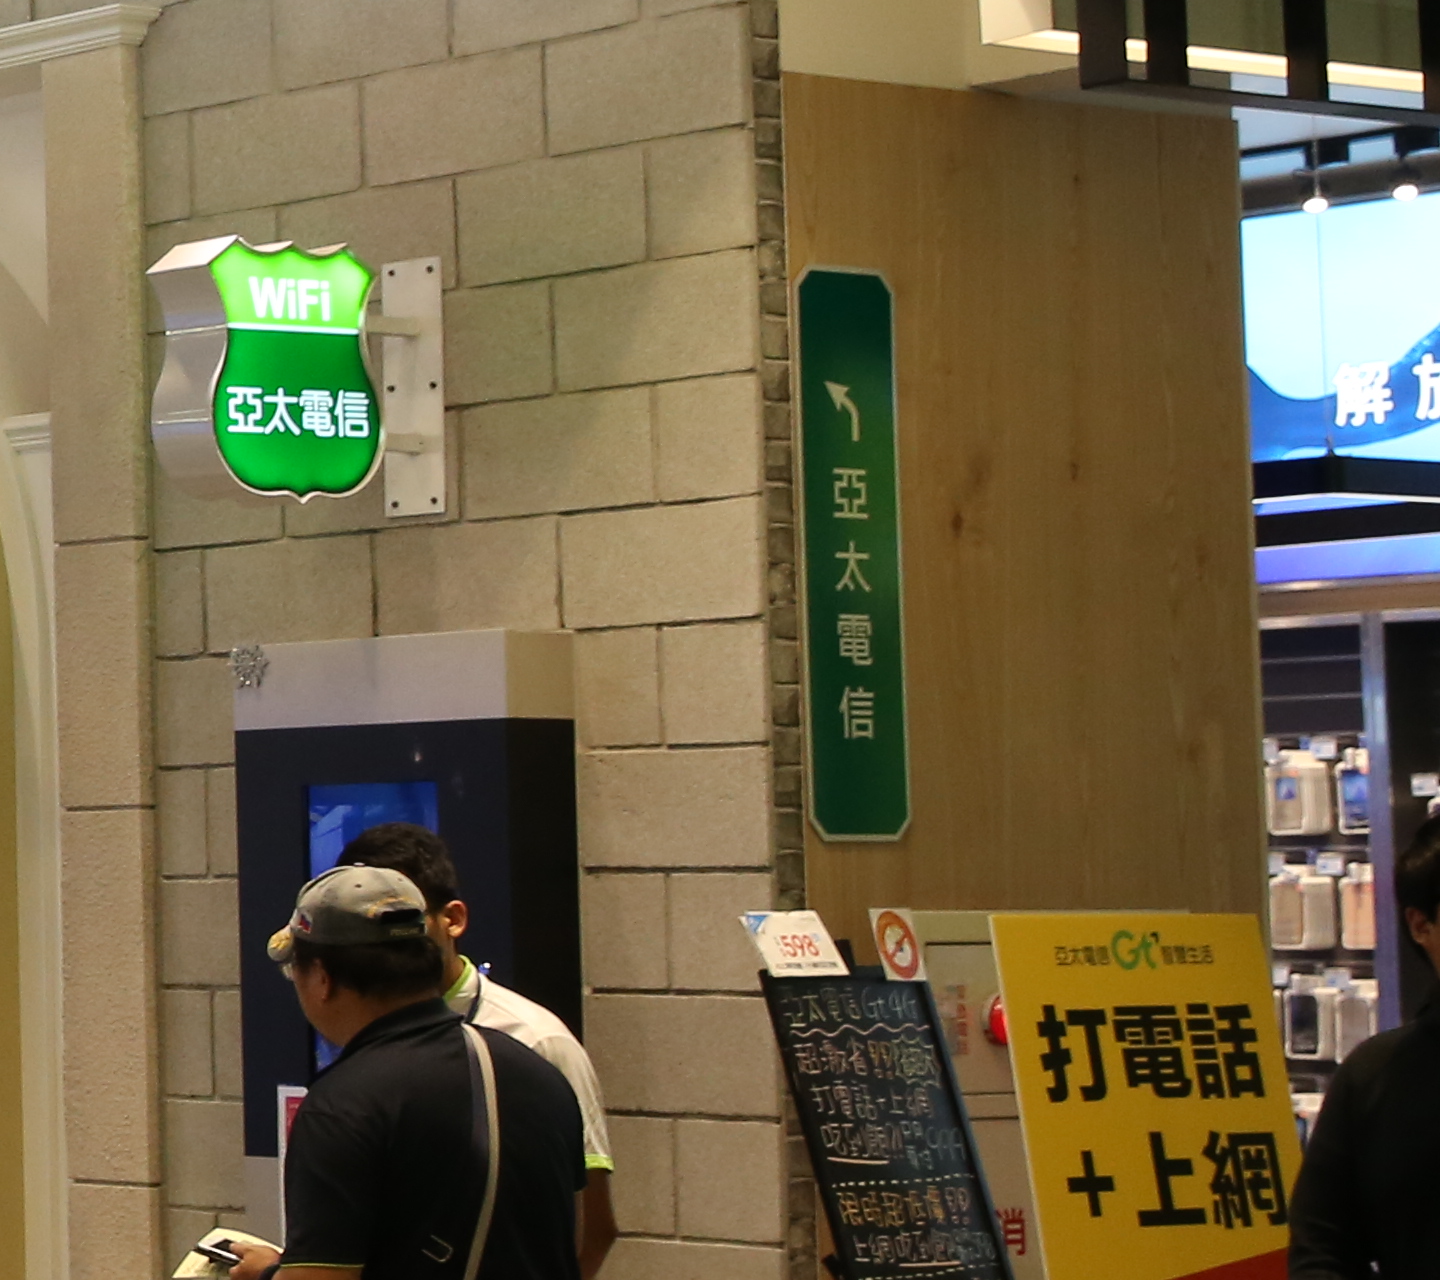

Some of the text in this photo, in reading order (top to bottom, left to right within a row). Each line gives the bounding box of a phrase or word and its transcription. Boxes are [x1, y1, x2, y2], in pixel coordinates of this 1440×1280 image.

[248, 276, 331, 321] WiFi
[226, 386, 370, 438] 亞太電信
[832, 467, 875, 740] 亞太電信
[1037, 1003, 1266, 1104] 打電話
[1137, 1131, 1289, 1230] 上網
